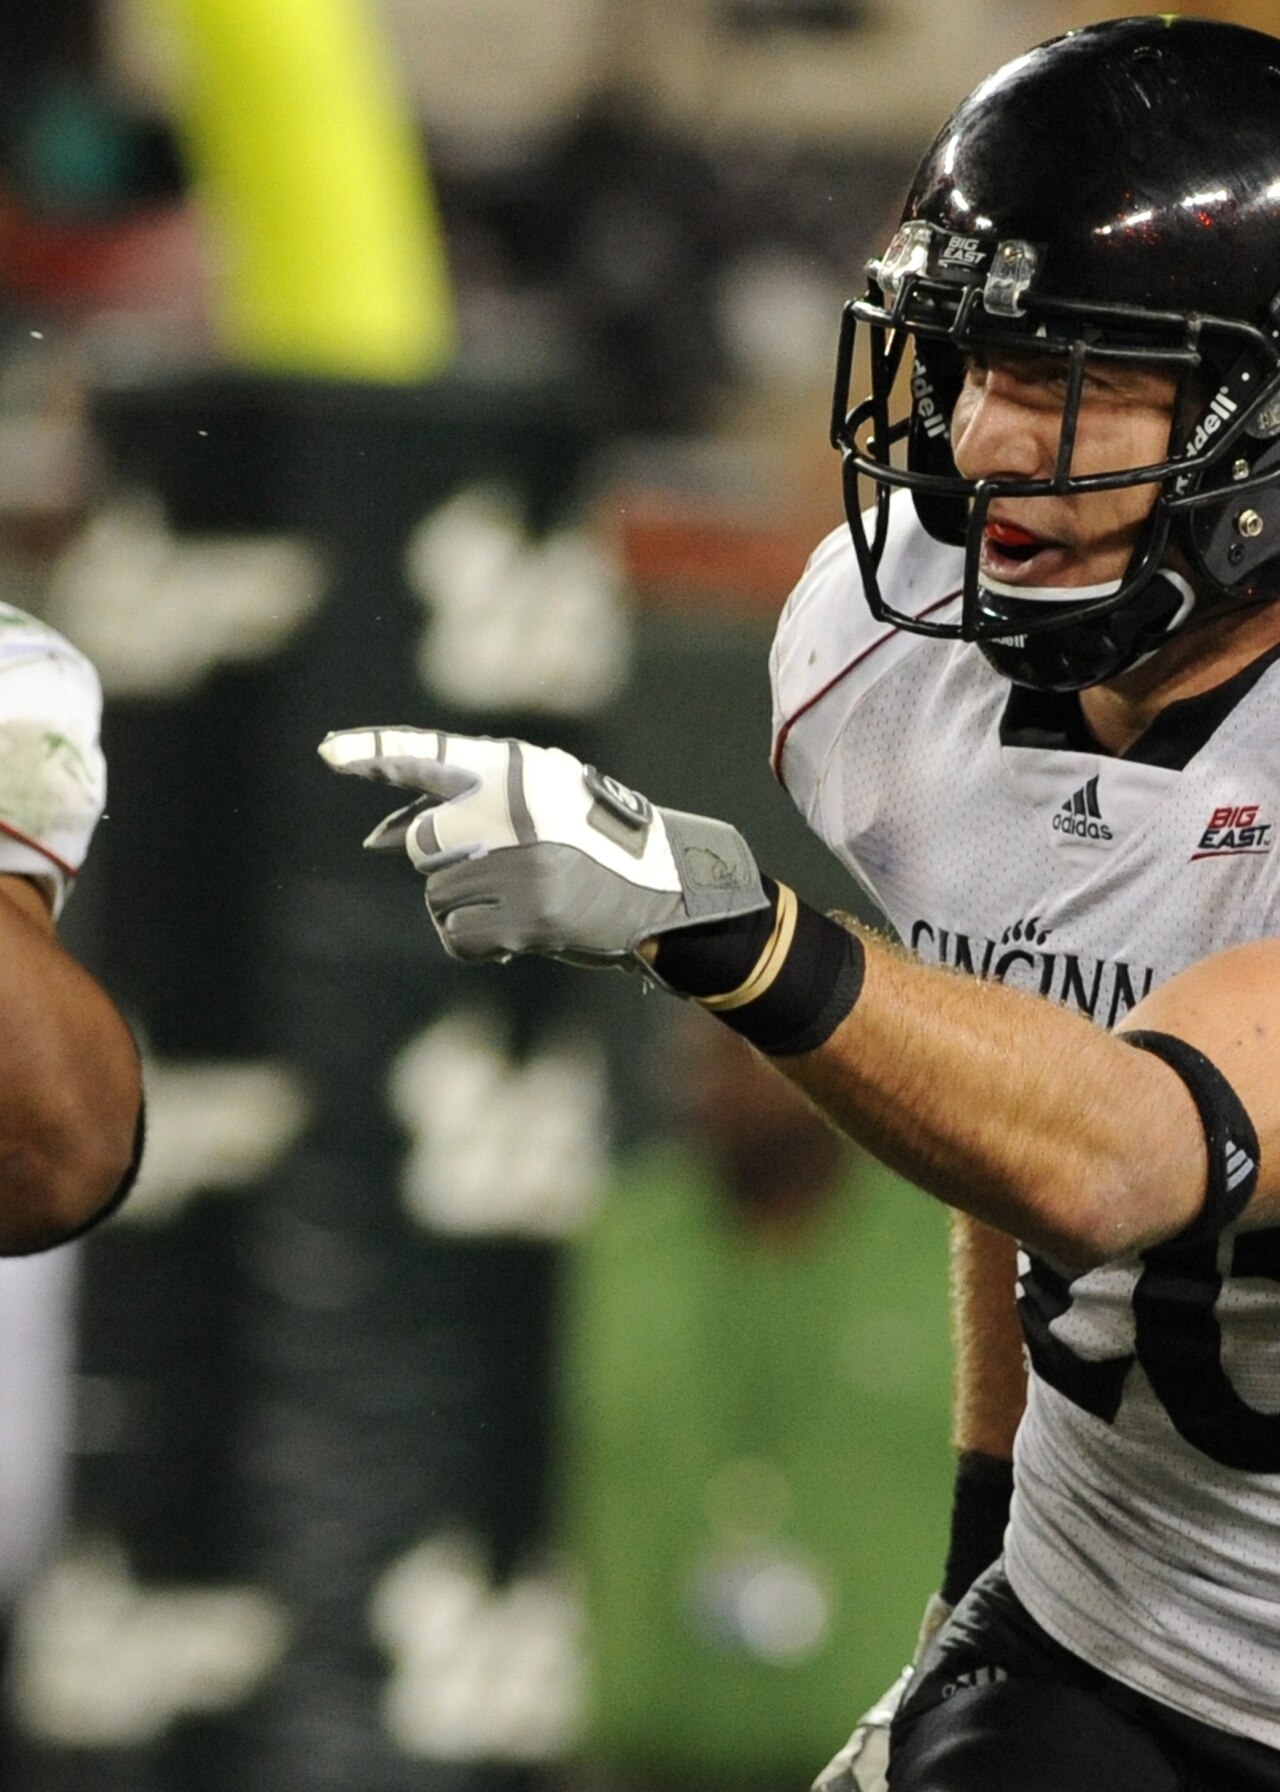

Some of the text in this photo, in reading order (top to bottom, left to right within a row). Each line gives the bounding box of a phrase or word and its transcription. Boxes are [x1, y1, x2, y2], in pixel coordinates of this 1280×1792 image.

[943, 247, 987, 264] EAST
[948, 235, 980, 251] BIG
[1052, 813, 1113, 841] adidas
[1207, 805, 1261, 830] BIG
[1197, 824, 1272, 849] EAST
